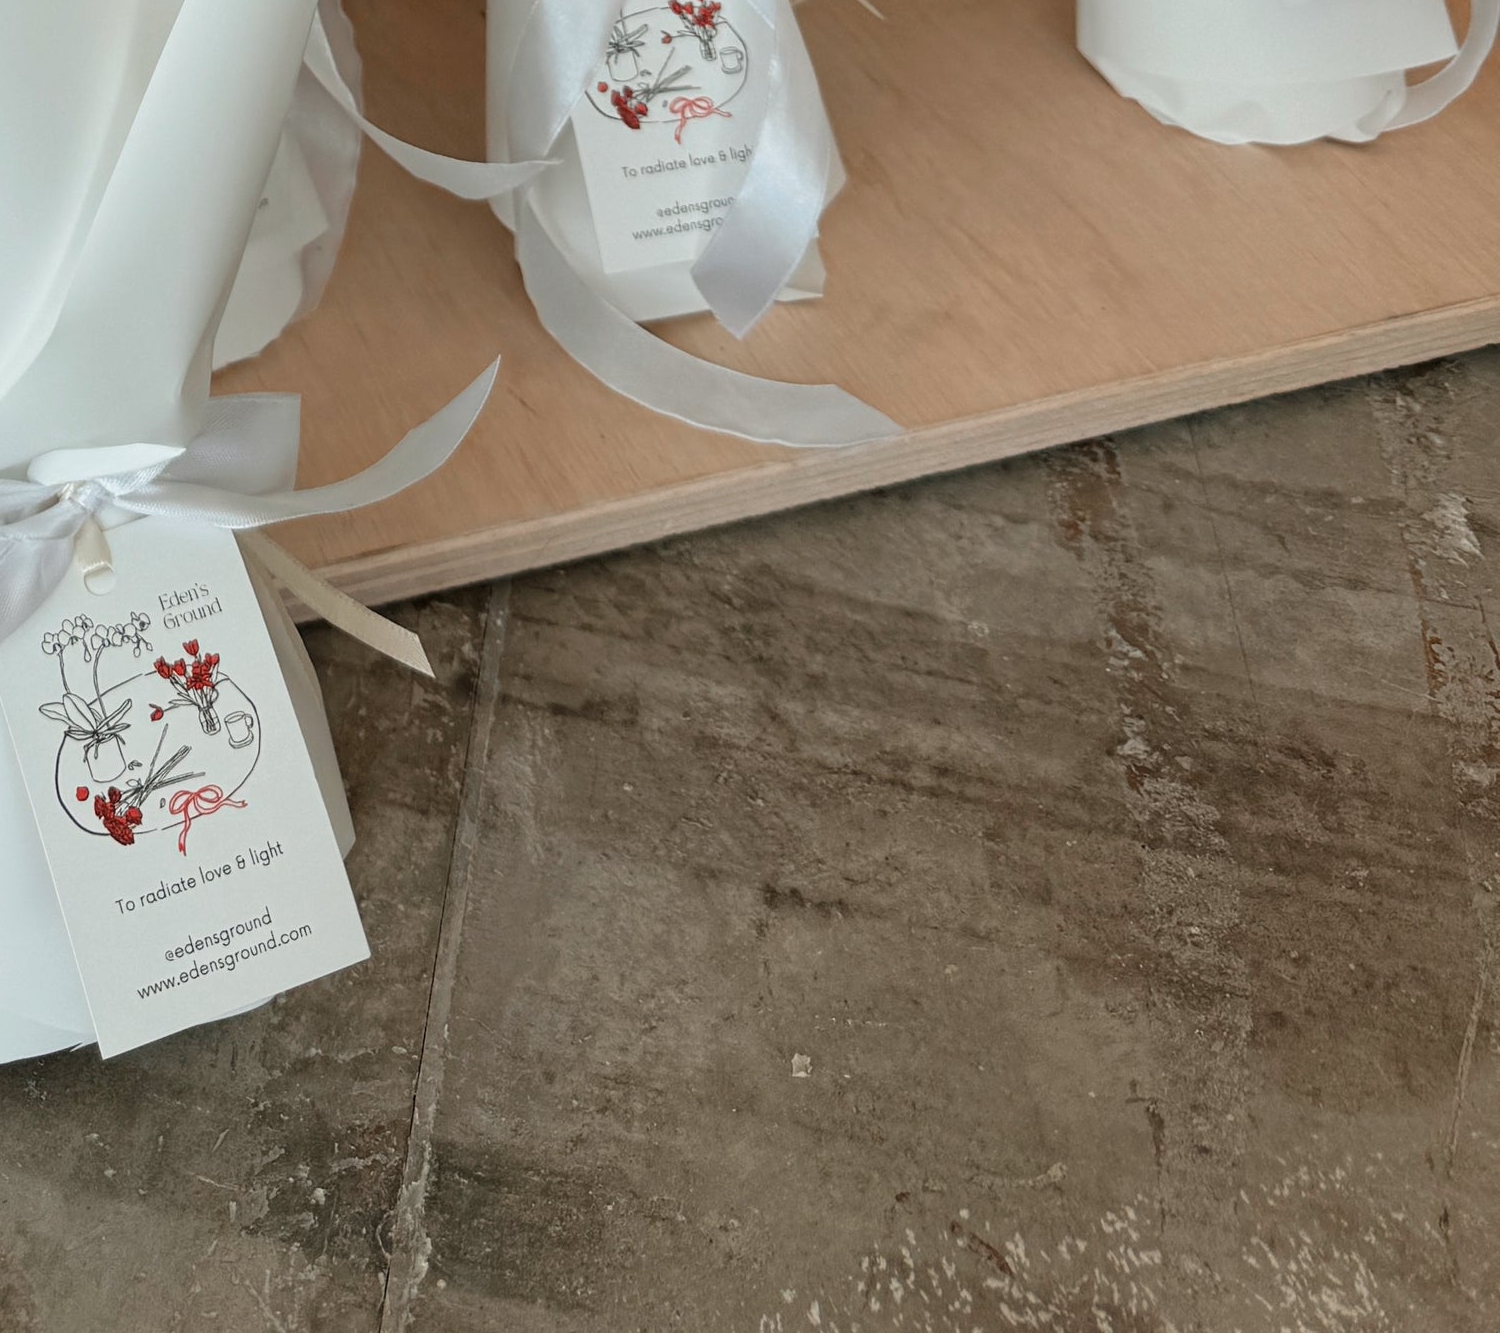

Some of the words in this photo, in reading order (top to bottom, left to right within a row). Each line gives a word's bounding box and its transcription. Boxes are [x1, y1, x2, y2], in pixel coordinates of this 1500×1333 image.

[622, 166, 637, 177] To
[640, 159, 687, 174] radiate
[688, 153, 715, 166] love
[729, 143, 753, 162] ligh
[656, 196, 734, 217] @edensgroun
[632, 216, 724, 239] www.edensgro
[158, 582, 209, 611] Eden's
[163, 597, 222, 630] Ground
[115, 899, 135, 914] To
[140, 881, 196, 907] radiate
[199, 866, 232, 883] love
[235, 855, 246, 869] &
[249, 841, 284, 866] light
[164, 906, 273, 962] @edensground
[137, 924, 312, 1000] www.edensground.com
